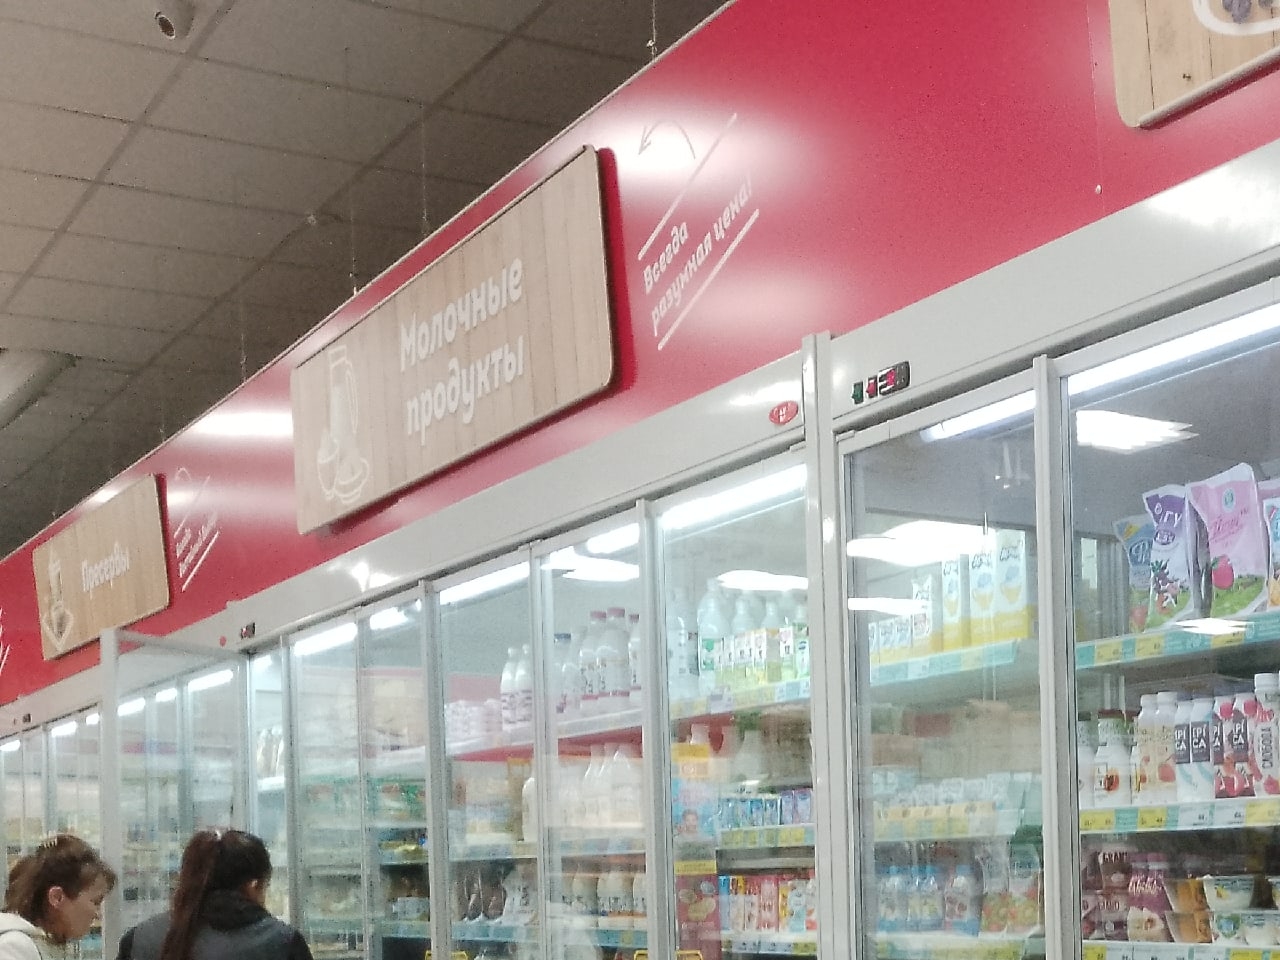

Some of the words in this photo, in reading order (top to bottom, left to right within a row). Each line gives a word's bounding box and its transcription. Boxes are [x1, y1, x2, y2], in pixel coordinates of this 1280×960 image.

[643, 222, 688, 294] Всегда
[652, 232, 712, 336] разумная
[400, 257, 523, 373] Молочные
[407, 335, 524, 446] продукты
